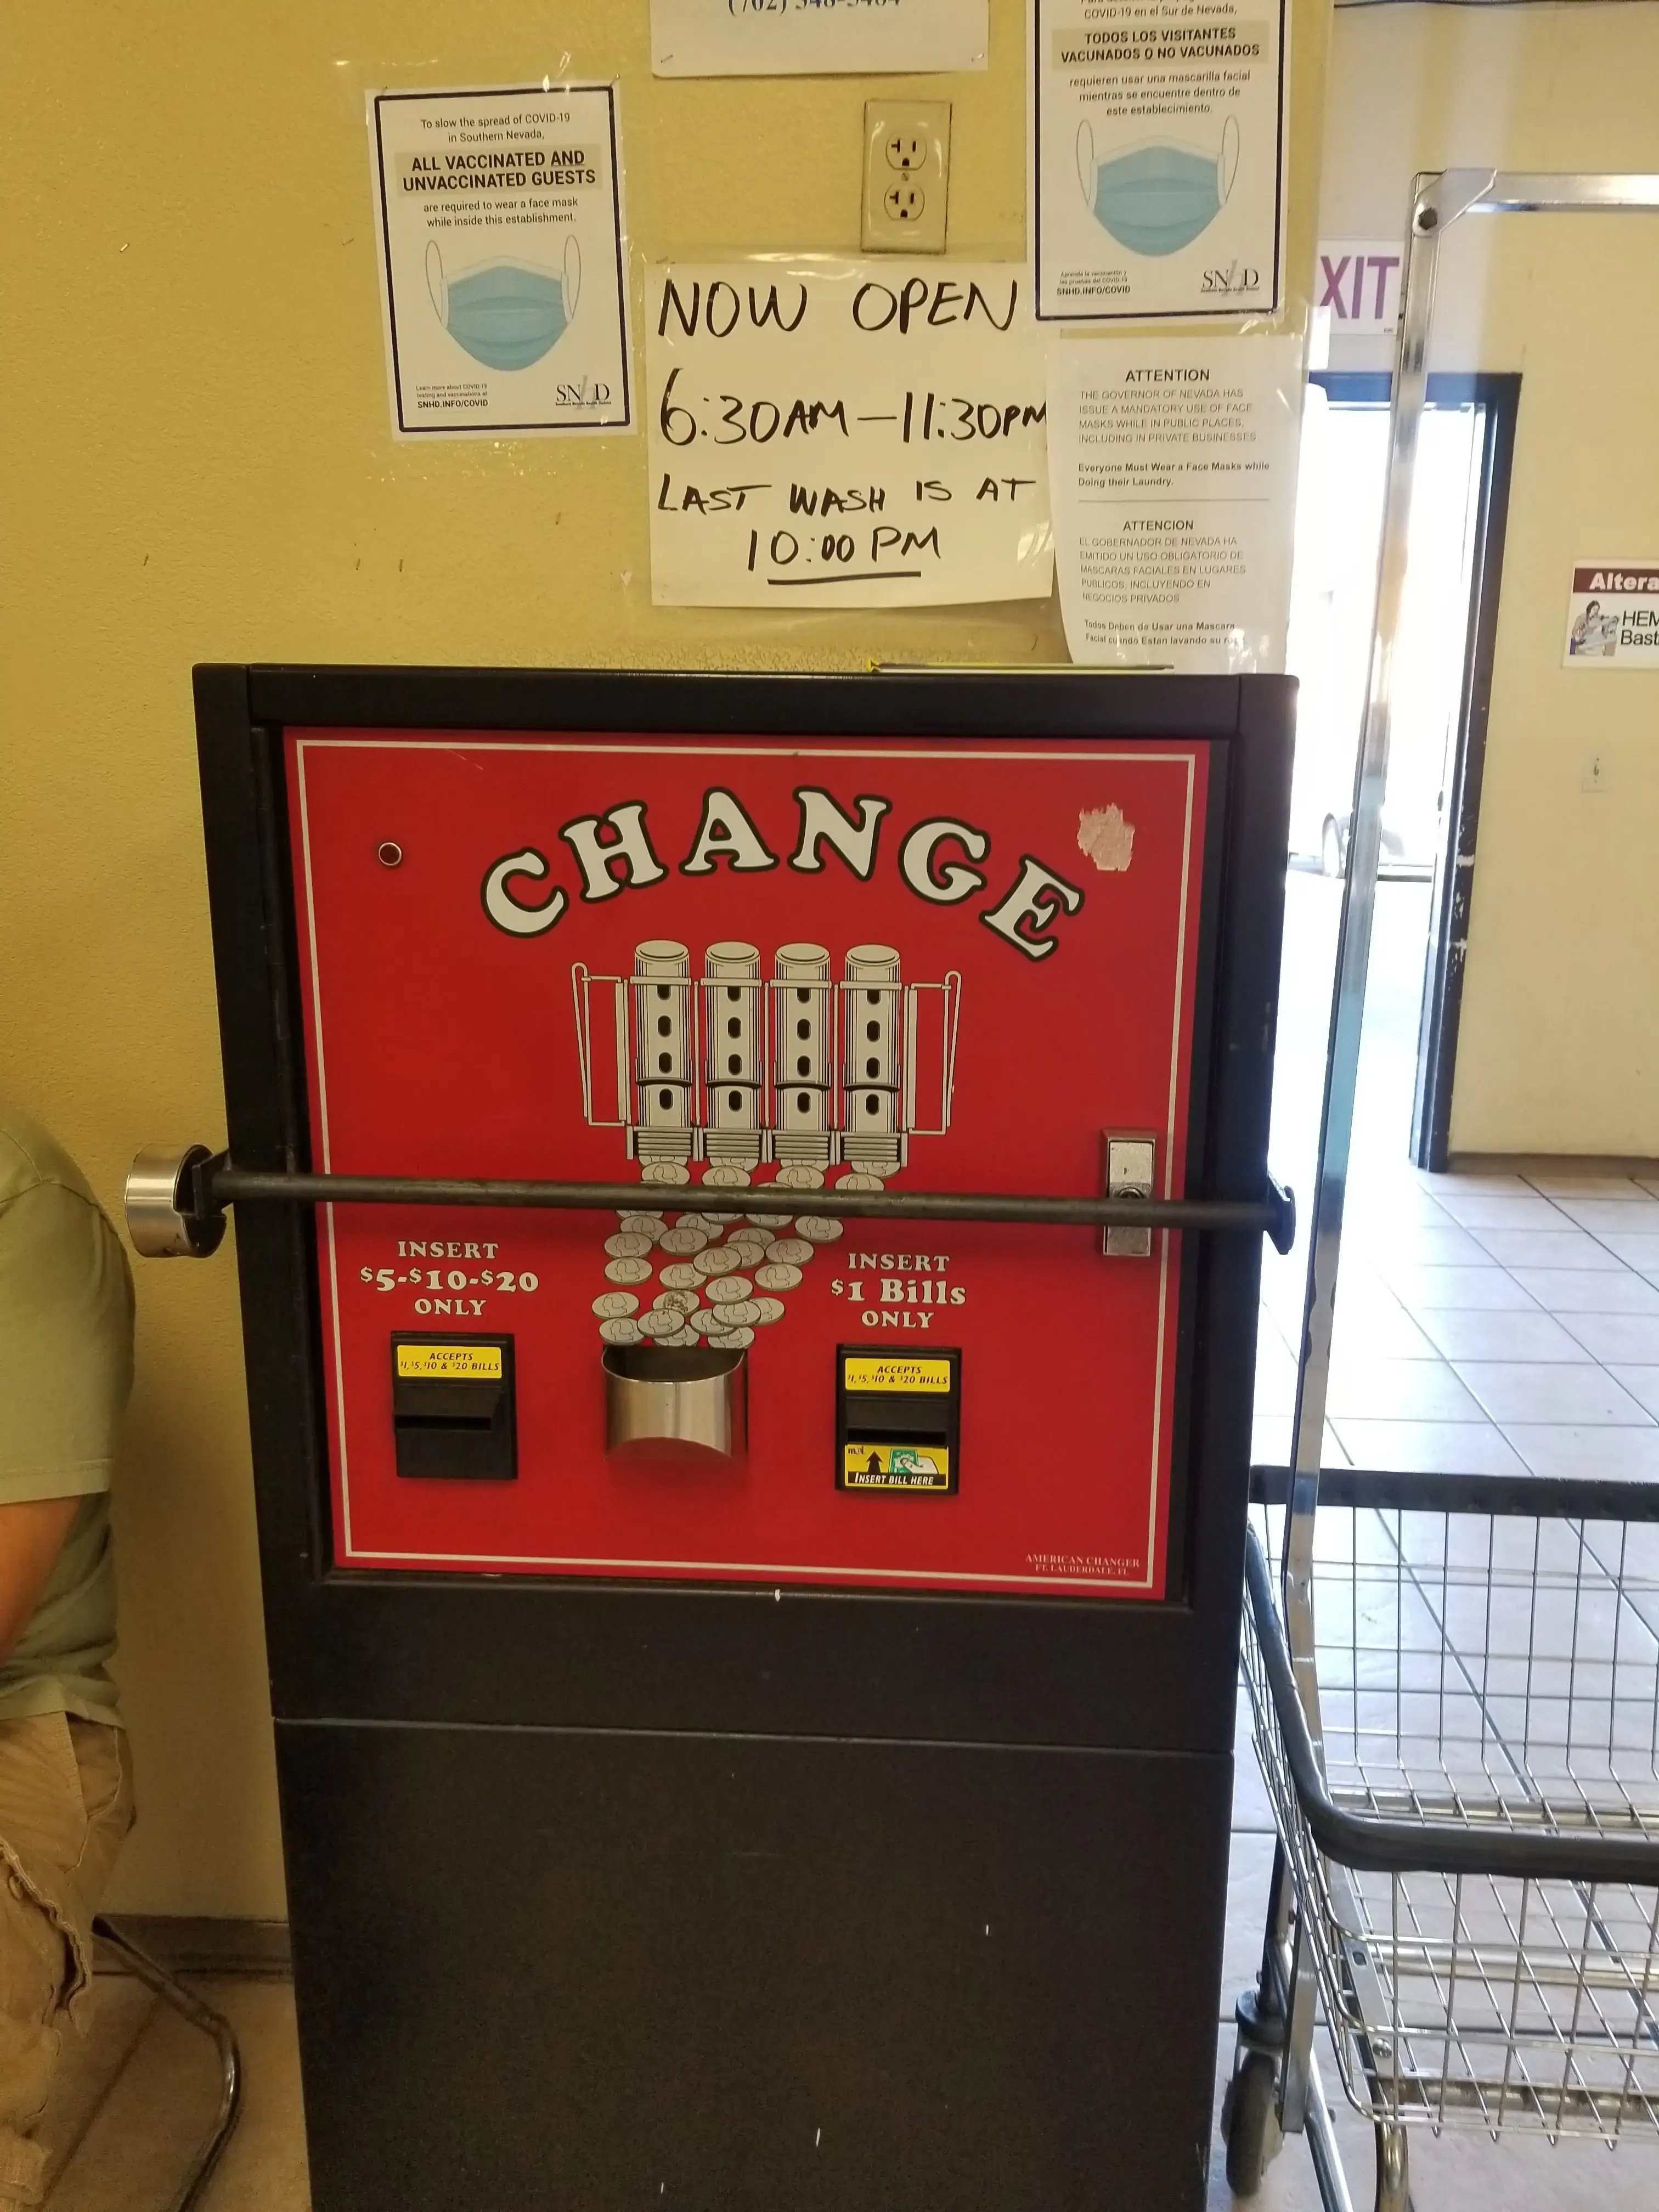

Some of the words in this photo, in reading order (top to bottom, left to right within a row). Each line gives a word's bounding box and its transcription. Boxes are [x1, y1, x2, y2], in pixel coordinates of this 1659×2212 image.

[1135, 9, 1146, 18] en
[1150, 7, 1158, 16] el
[1161, 5, 1178, 15] Sur
[1181, 5, 1193, 15] de
[1197, 3, 1237, 15] Nevada,
[1085, 31, 1128, 44] TODOS
[1132, 31, 1156, 42] LOS
[1161, 27, 1235, 42] VISITANTES
[1061, 48, 1139, 63] VACUNADOS
[1144, 48, 1153, 60] O
[1158, 47, 1175, 59] NO
[1180, 44, 1259, 58] VACUNADOS
[1070, 77, 1118, 88] requieren
[1121, 75, 1144, 84] usar
[1147, 74, 1165, 83] una
[1169, 71, 1220, 83] mascarilla
[1223, 70, 1250, 81] facial
[1079, 91, 1123, 102] mientras
[1141, 88, 1190, 99] encuentre
[1194, 86, 1225, 98] dentro
[1228, 87, 1240, 96] de
[1107, 106, 1127, 116] este
[421, 119, 432, 129] To
[436, 116, 456, 128] slow
[460, 116, 475, 127] the
[478, 115, 510, 128] spread
[514, 114, 522, 125] of
[526, 112, 570, 123] COVID-19
[448, 132, 456, 143] in
[460, 131, 503, 142] Southern
[506, 129, 544, 140] Nevada,
[411, 157, 441, 171] ALL
[445, 152, 545, 169] VACCINATED
[551, 150, 584, 166] AND
[403, 172, 526, 191] UNVACCINATED
[532, 169, 596, 185] GUESTS
[424, 204, 438, 212] are
[441, 201, 479, 213] required
[529, 198, 549, 207] face
[552, 196, 578, 206] mask
[427, 217, 452, 227] while
[455, 215, 482, 225] inside
[486, 215, 502, 224] this
[658, 278, 807, 338] NOW
[853, 278, 1017, 334] OPEN
[1125, 369, 1210, 382] ATTENTION
[1081, 391, 1098, 400] THE
[1102, 390, 1159, 399] GOVERNOR
[1163, 390, 1176, 398] OF
[1180, 390, 1220, 398] NEVADA
[1223, 389, 1243, 398] HAS
[417, 399, 488, 408] SNHD.INFO/COVID
[1079, 405, 1108, 414] ISSUE
[1111, 405, 1118, 414] A
[1121, 404, 1183, 414] MANDATORY
[1187, 404, 1205, 413] USE
[1210, 404, 1222, 413] OF
[1227, 403, 1251, 412] FACE
[1079, 420, 1113, 429] MASKS
[1116, 419, 1146, 428] WHILE
[1151, 419, 1160, 427] IN
[1164, 419, 1199, 427] PUBLIC
[1079, 435, 1132, 443] INCLUDING
[1136, 434, 1145, 443] IN
[1149, 433, 1189, 443] PRIVATE
[1192, 433, 1256, 442] BUSINESSES
[1079, 464, 1121, 474] Everyone
[1126, 464, 1147, 472] Must
[1186, 463, 1209, 471] Face
[1211, 462, 1241, 471] Masks
[1245, 462, 1269, 470] while
[1079, 478, 1105, 487] Doing
[1108, 478, 1129, 486] their
[658, 474, 772, 515] LAST
[790, 484, 885, 516] WASH
[916, 481, 952, 501] IS
[977, 477, 1036, 501] AT
[1123, 520, 1193, 531] ATTENCION
[1080, 538, 1089, 546] EL
[1092, 538, 1161, 546] GOBERNADOR
[1165, 537, 1176, 546] DE
[1181, 537, 1220, 546] NEVADA
[1223, 537, 1237, 545] HA
[748, 530, 854, 571] 10:00
[872, 527, 940, 561] PM
[1080, 551, 1116, 561] EMITIDO
[1120, 552, 1133, 561] UN
[1137, 552, 1157, 561] USO
[1160, 551, 1227, 561] OBLIGATORIO
[1230, 551, 1243, 560] DE
[1081, 565, 1130, 575] MASCARAS
[1134, 565, 1180, 574] FACIALES
[1183, 565, 1196, 574] EN
[1199, 565, 1246, 574] LUGARES
[1130, 579, 1193, 589] INCLUYENDO
[1197, 579, 1210, 588] EN
[1083, 593, 1127, 603] NEGOCIOS
[1130, 594, 1180, 602] PRIVADOS
[1085, 620, 1105, 629] Todos
[1138, 623, 1149, 631] de
[1152, 622, 1173, 631] Usar
[1176, 623, 1193, 631] una
[1196, 622, 1235, 631] Mascara
[480, 786, 1084, 962] CHANGE
[397, 1240, 499, 1259] INSERT
[848, 1252, 950, 1272] INSERT
[360, 1266, 539, 1293] $5-$10-$20
[831, 1279, 865, 1302] $1
[881, 1278, 967, 1305] Bills
[414, 1299, 487, 1316] ONLY
[862, 1310, 934, 1328] ONLY
[877, 1365, 922, 1374] ACCEPTS
[1026, 1554, 1084, 1564] AMERICAN
[1086, 1556, 1139, 1567] CHANGER
